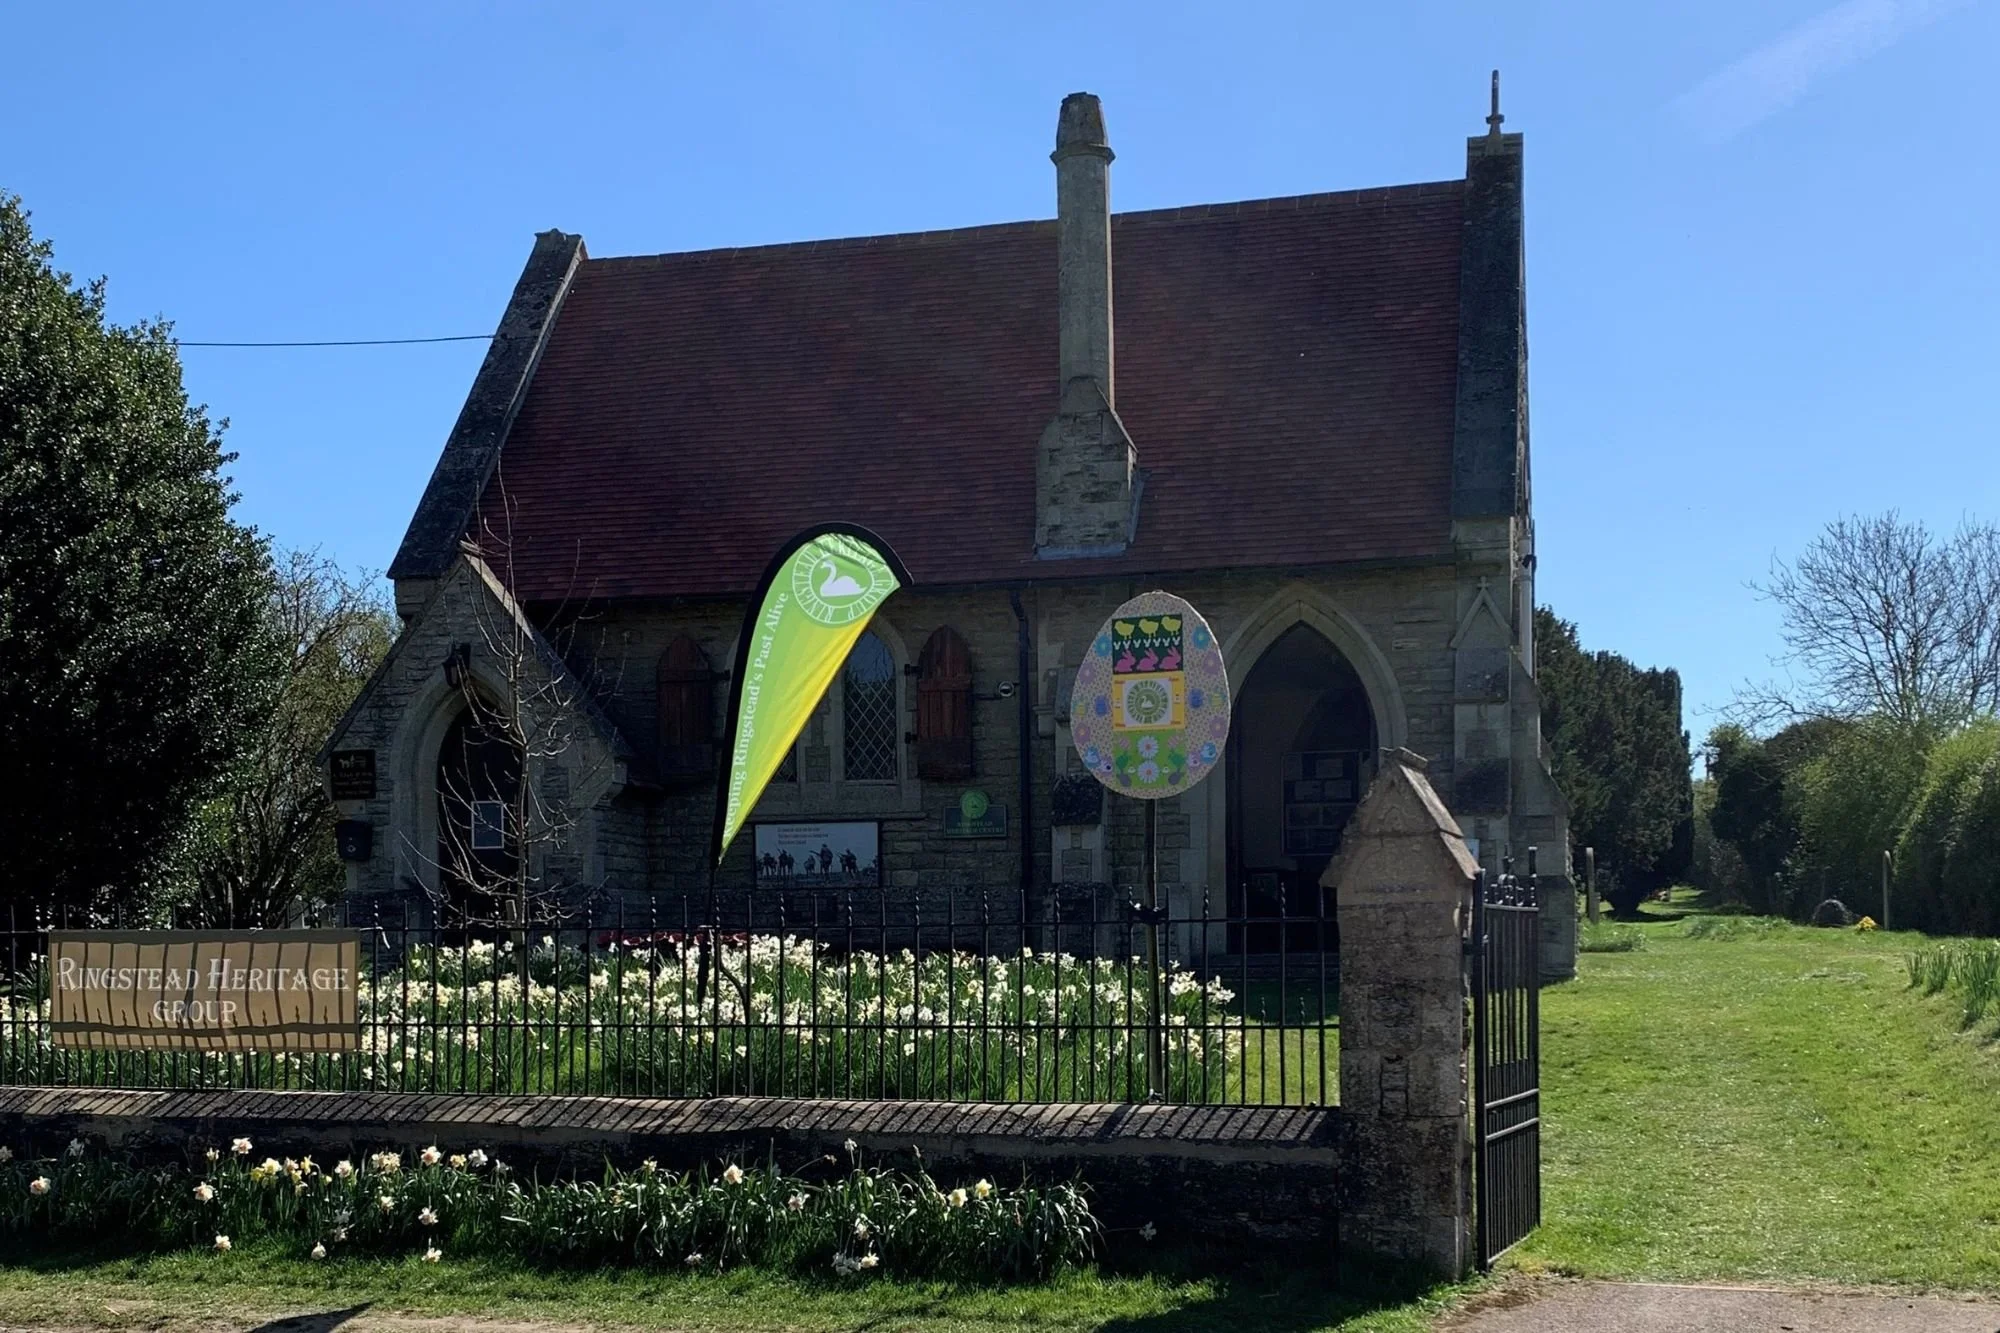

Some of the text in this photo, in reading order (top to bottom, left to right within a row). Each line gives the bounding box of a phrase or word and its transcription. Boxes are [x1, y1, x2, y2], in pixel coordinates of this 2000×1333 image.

[735, 674, 763, 767] Ringstead's
[754, 635, 774, 669] Past
[767, 591, 788, 633] Alive
[56, 957, 349, 992] RINGSTEAD HERITAGE
[153, 1000, 237, 1024] GROUP
